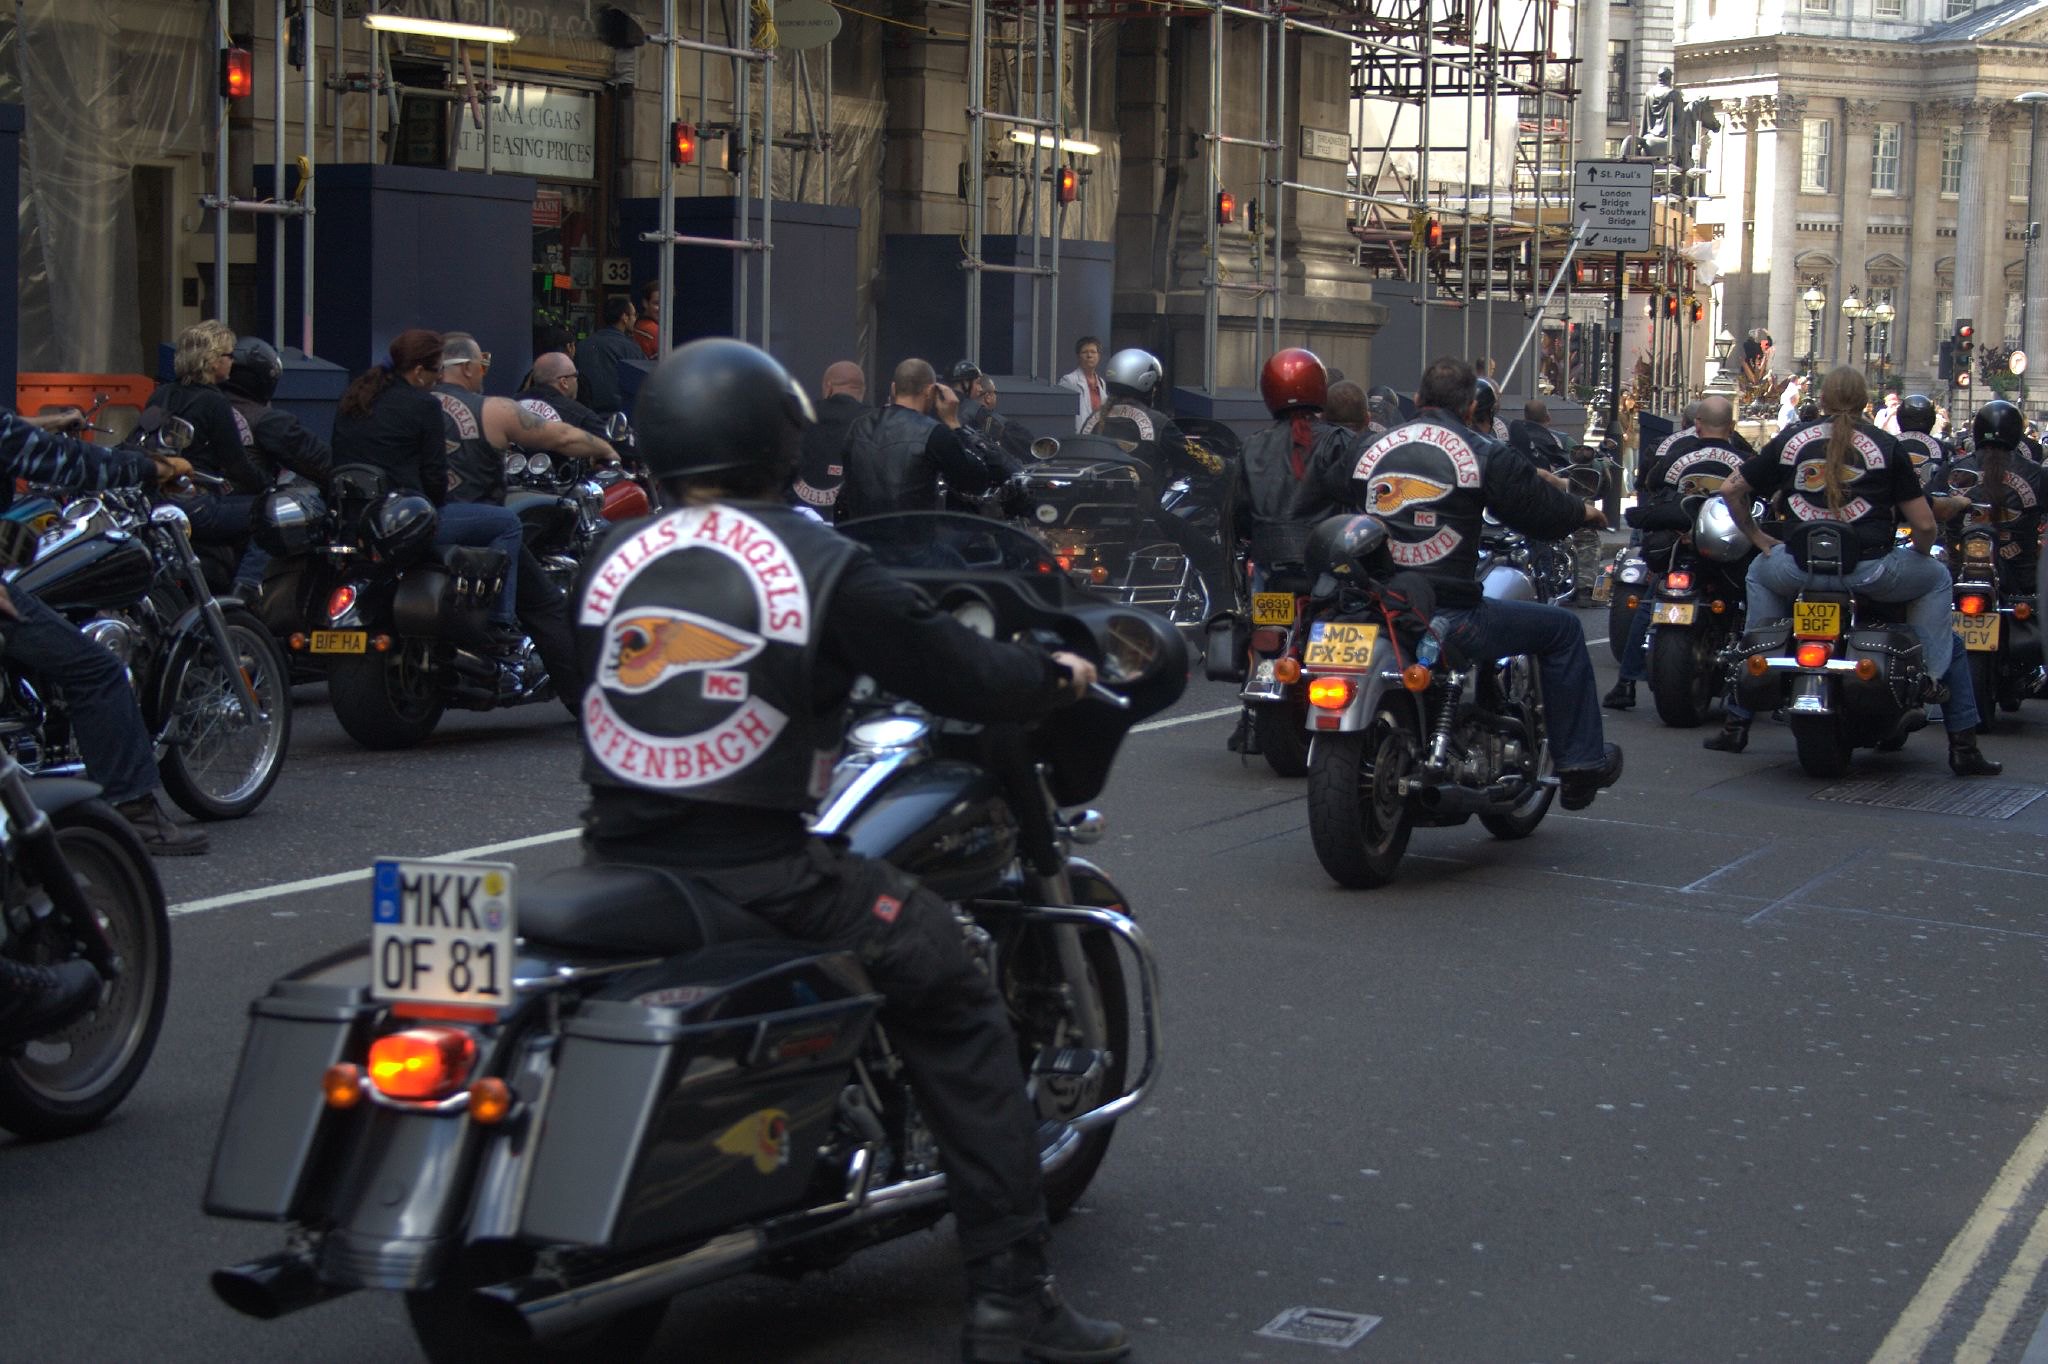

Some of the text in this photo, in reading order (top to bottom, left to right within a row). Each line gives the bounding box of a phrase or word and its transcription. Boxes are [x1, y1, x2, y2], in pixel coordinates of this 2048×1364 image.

[530, 108, 581, 131] CIGARS
[476, 134, 543, 158] PEASING
[547, 140, 592, 163] PRICES
[1600, 208, 1647, 216] Southwark
[1601, 199, 1630, 207] Bridge
[1608, 217, 1636, 226] Bridge
[1602, 236, 1637, 244] Aldgate
[608, 263, 629, 280] 33
[442, 395, 476, 436] NGELS
[1357, 427, 1477, 484] HELLS ANGELS
[1783, 427, 1883, 466] HELLS GELS
[1666, 452, 1702, 481] HELLS
[1417, 513, 1433, 523] MC
[1391, 533, 1454, 563] LLAND
[588, 511, 802, 631] HELLS ANGELS
[1796, 604, 1836, 617] LX07
[1328, 626, 1358, 643] MD
[1802, 619, 1832, 631] BGF
[706, 673, 743, 697] MC
[587, 696, 772, 781] OFFENBACH
[400, 872, 482, 929] MKK
[382, 936, 500, 995] OF 81
